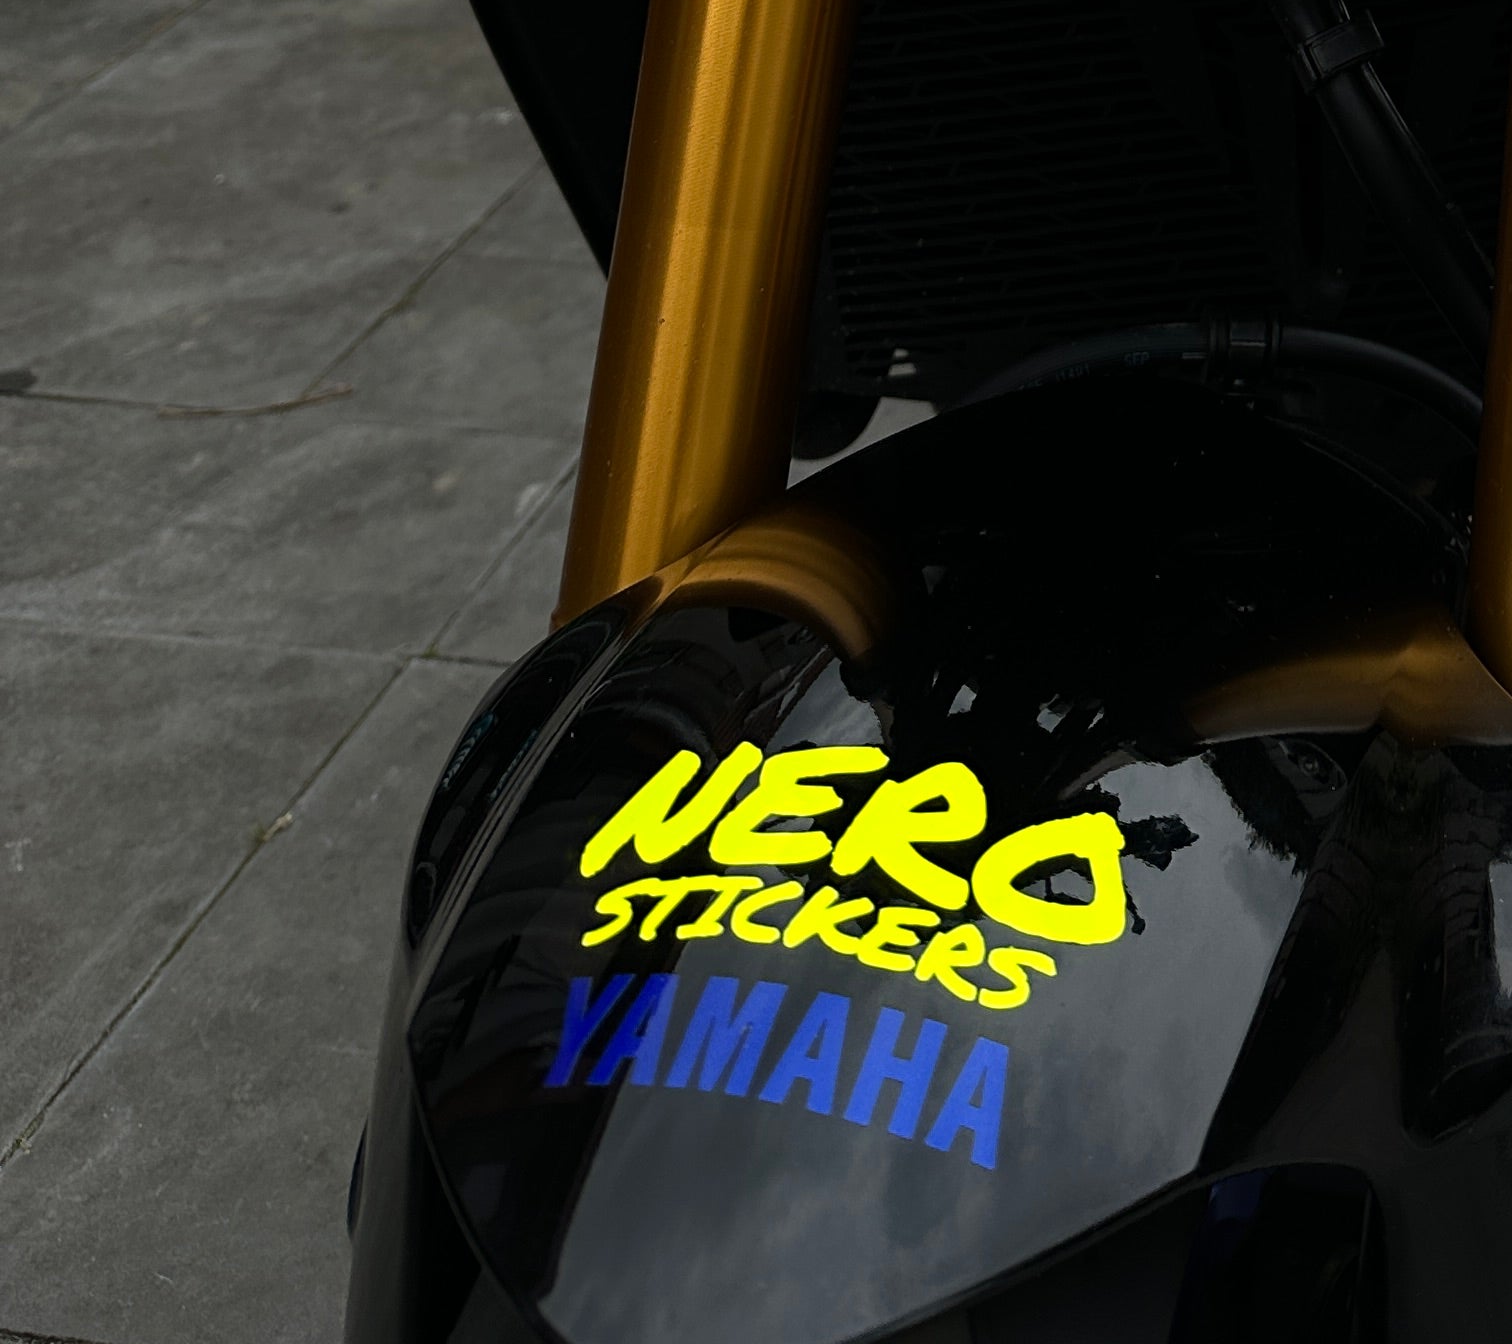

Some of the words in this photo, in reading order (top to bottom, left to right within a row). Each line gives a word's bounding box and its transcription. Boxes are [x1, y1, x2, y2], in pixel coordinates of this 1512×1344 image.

[580, 742, 1126, 946] NERO
[581, 875, 1057, 1010] STICKERS
[543, 973, 1010, 1170] YAMAHA
